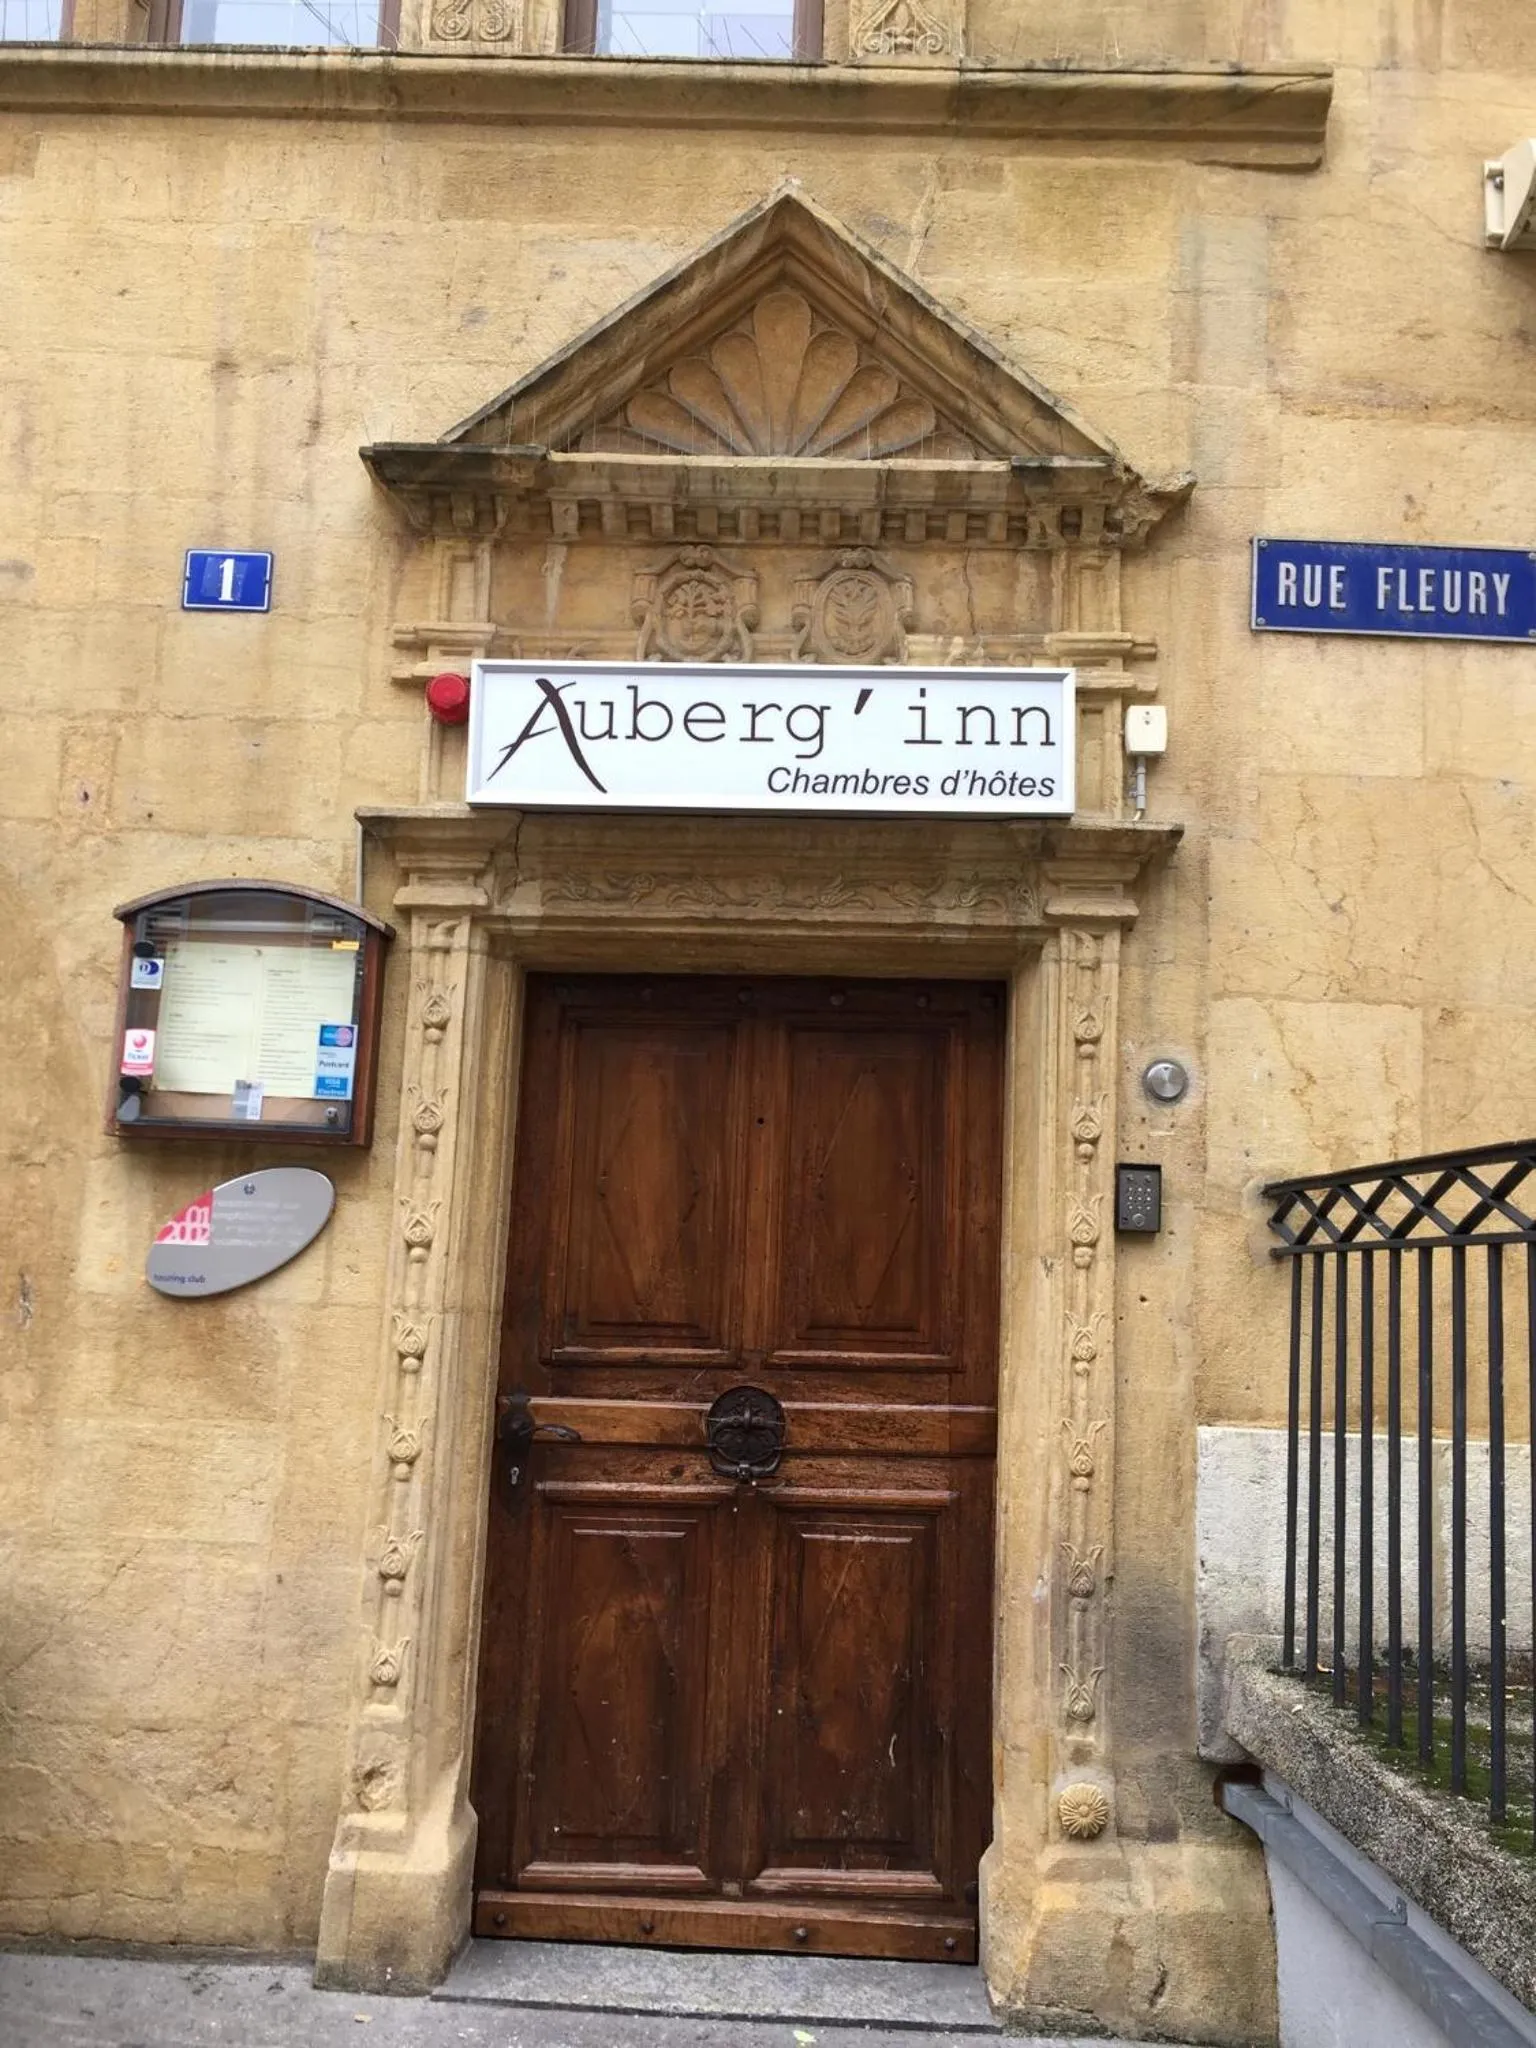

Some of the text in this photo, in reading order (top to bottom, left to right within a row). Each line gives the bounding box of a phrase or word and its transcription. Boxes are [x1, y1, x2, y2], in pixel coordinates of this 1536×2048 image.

[217, 558, 235, 602] 1
[1276, 561, 1511, 615] RUE FLEURY
[767, 766, 1056, 798] Chambres d'hôtes
